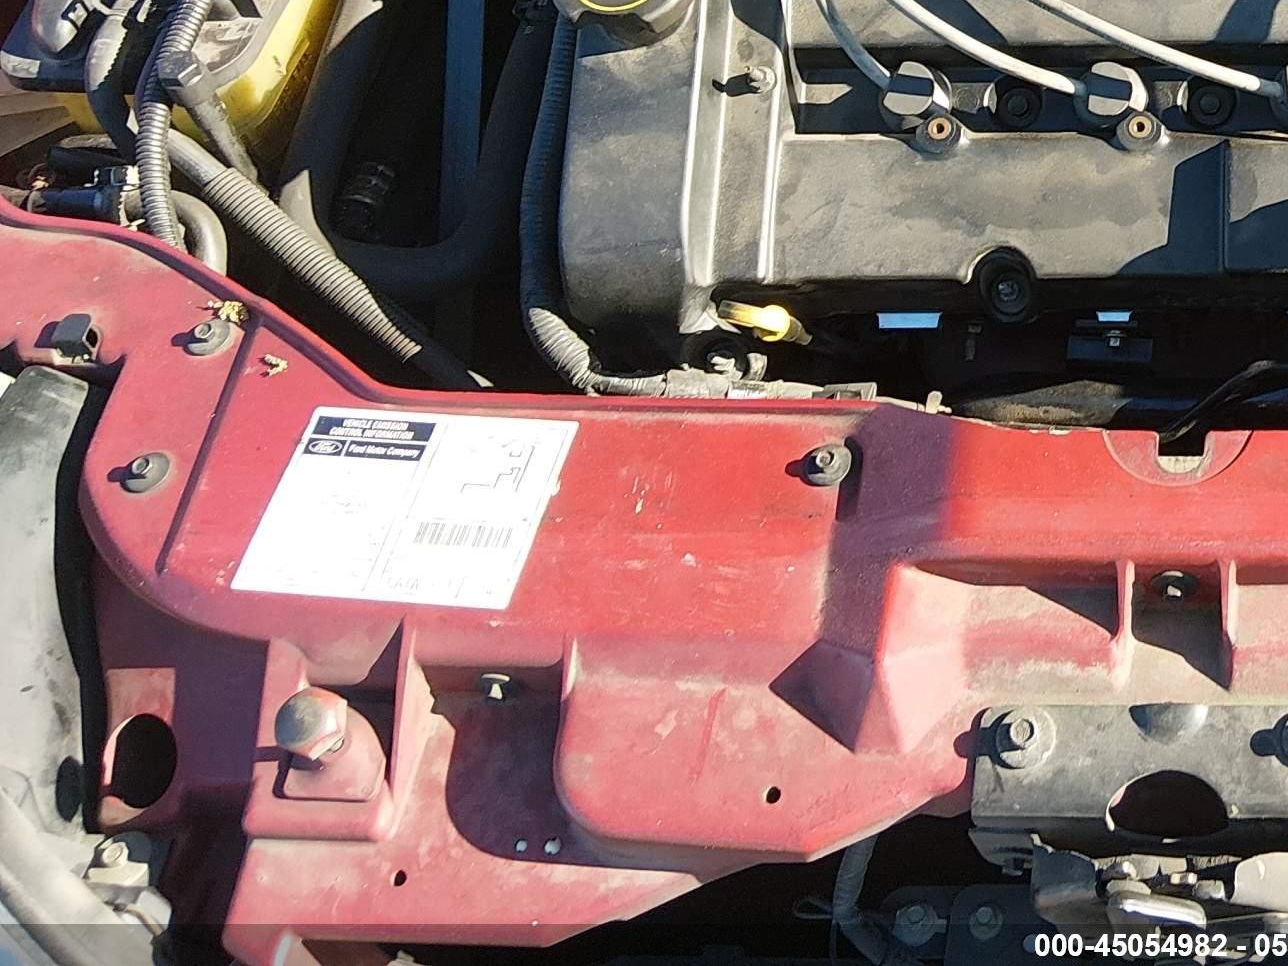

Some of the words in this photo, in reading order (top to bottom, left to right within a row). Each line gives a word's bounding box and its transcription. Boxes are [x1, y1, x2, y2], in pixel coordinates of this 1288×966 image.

[342, 418, 372, 429] VEHICLE
[329, 426, 363, 437] CONTROL
[362, 428, 415, 441] INFORMATION
[387, 446, 420, 459] Company
